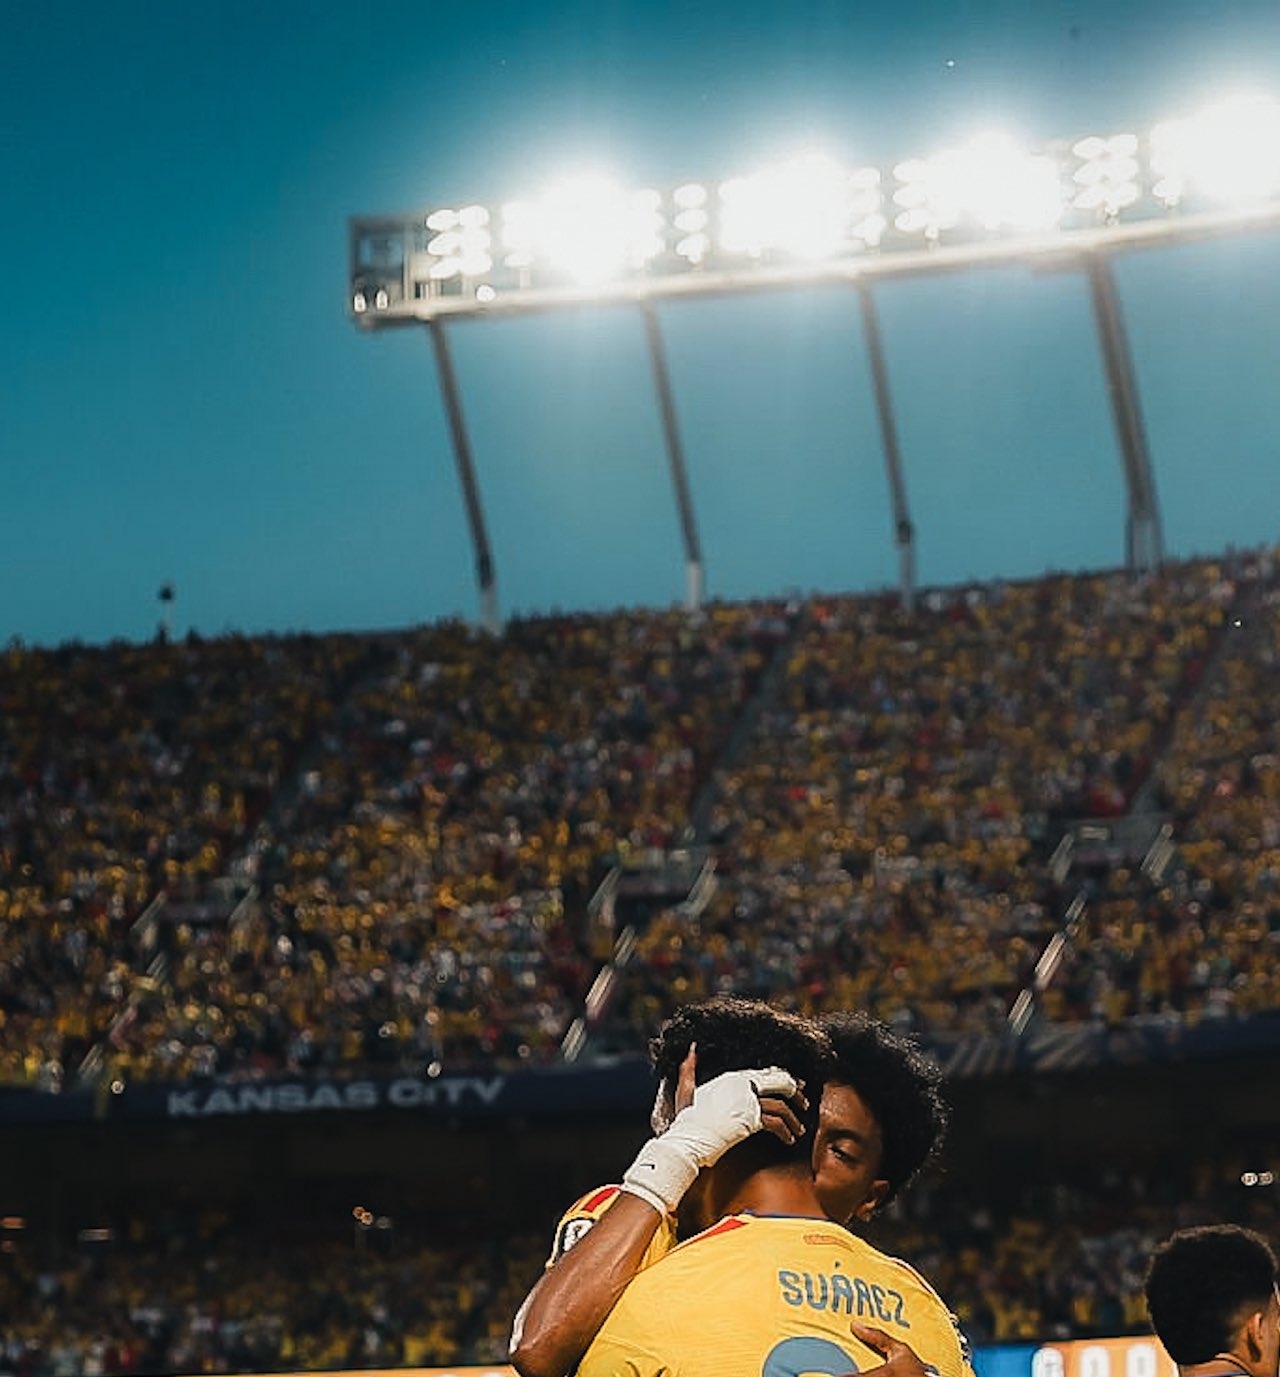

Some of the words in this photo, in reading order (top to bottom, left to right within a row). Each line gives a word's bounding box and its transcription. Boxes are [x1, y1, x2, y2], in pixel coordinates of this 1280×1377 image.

[168, 1082, 377, 1116] KANSAS
[388, 1077, 505, 1107] CITY
[778, 1260, 910, 1328] SUÁREZ
